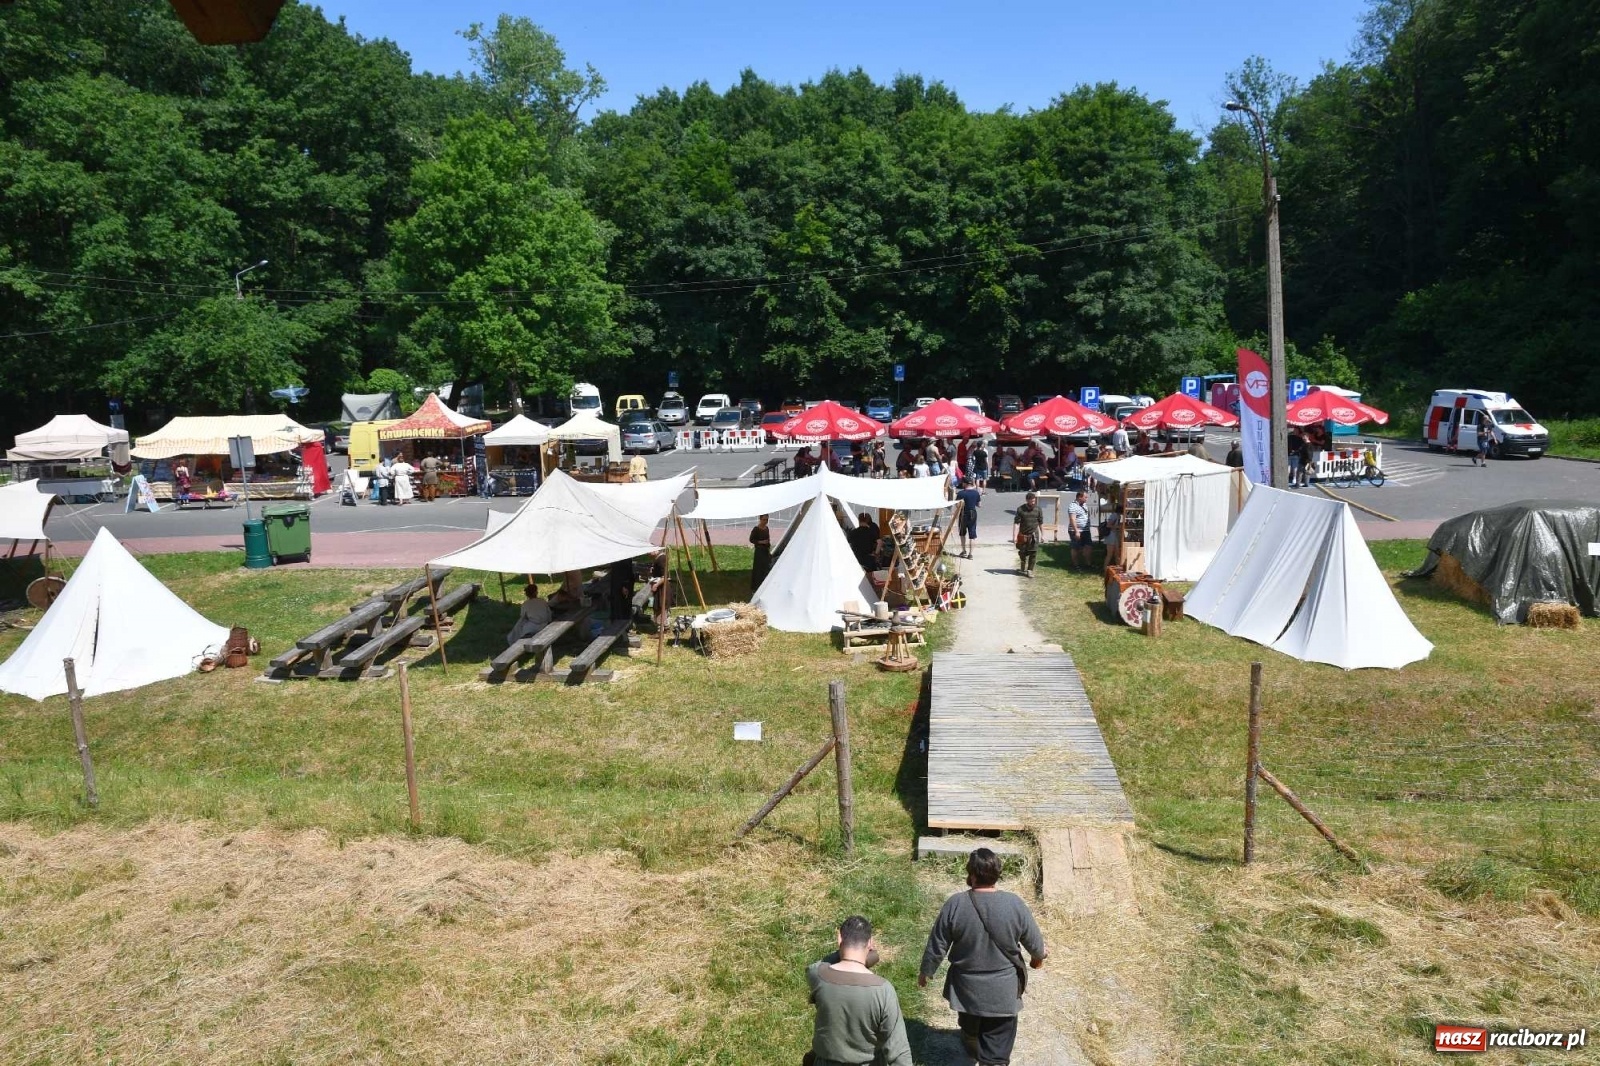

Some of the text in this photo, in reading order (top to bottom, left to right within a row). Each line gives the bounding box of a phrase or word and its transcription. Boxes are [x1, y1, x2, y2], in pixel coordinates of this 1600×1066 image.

[1186, 379, 1197, 394] P
[1293, 381, 1304, 396] P
[1085, 389, 1096, 404] P
[379, 428, 445, 440] KAWIARENKA
